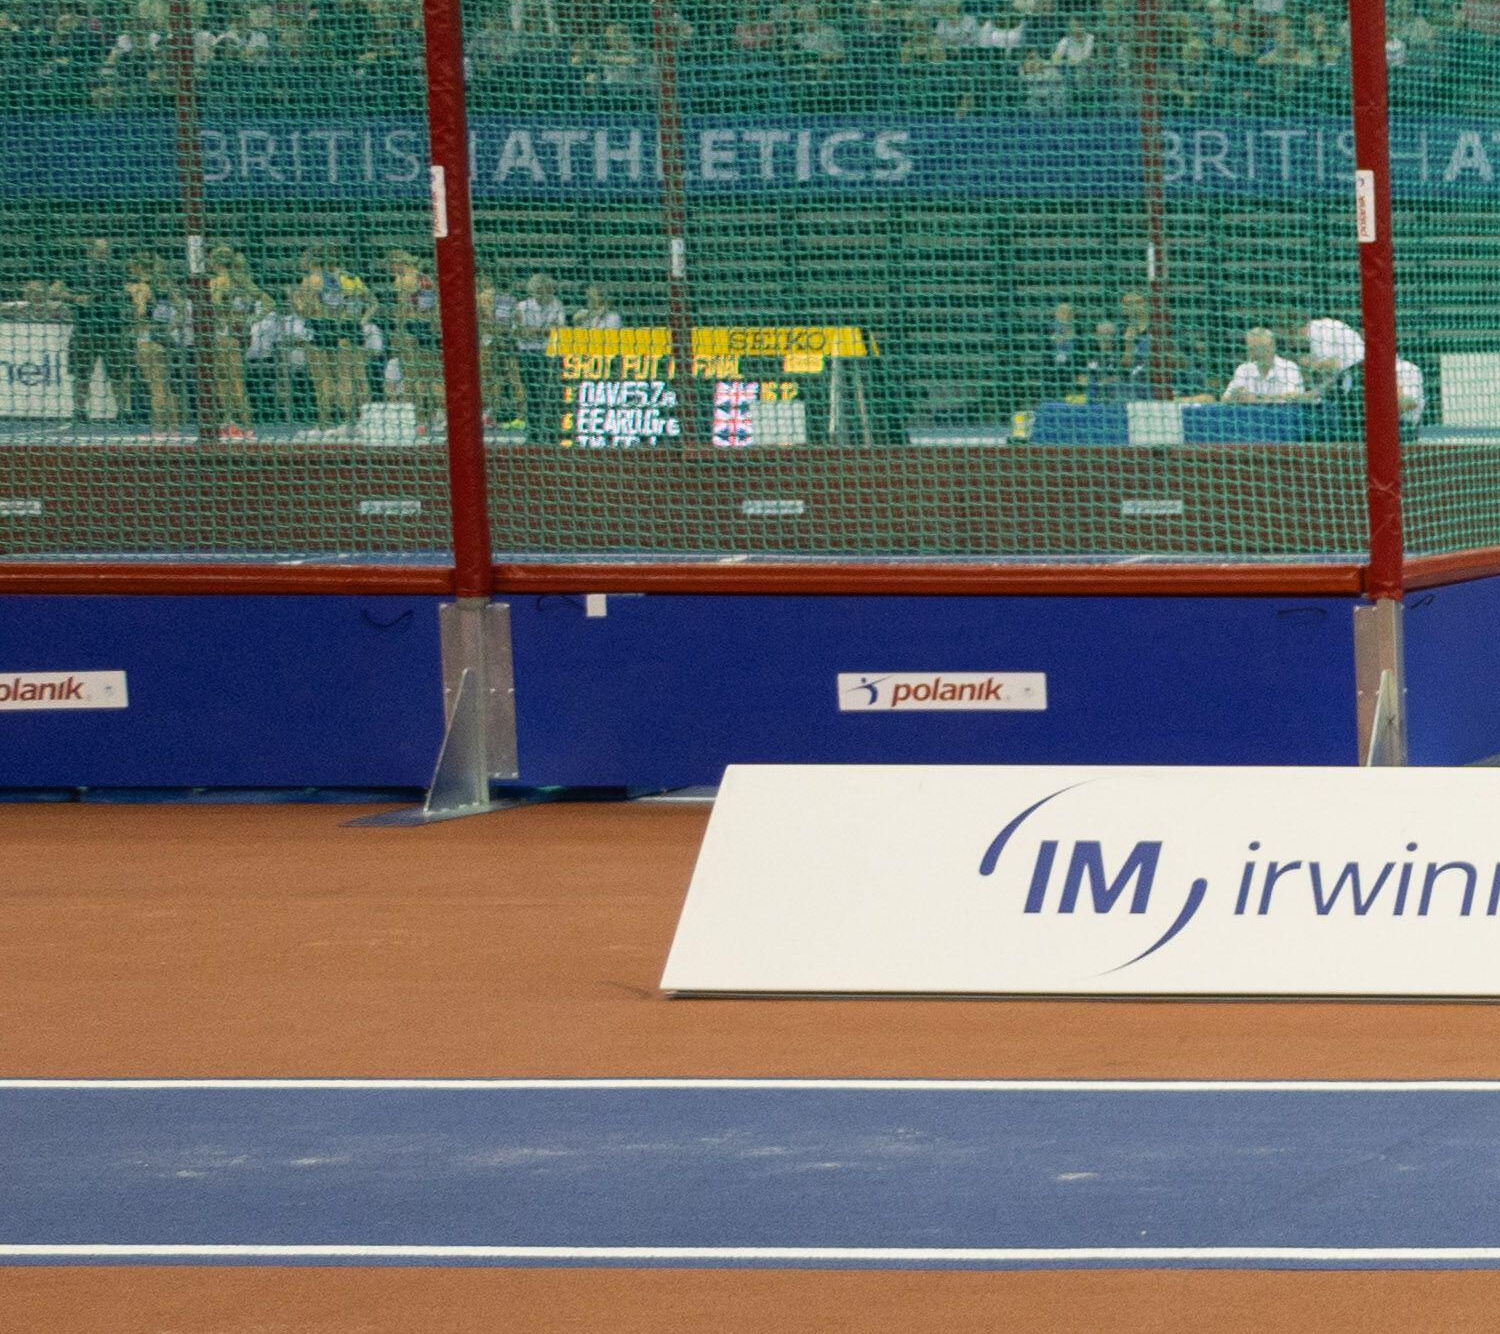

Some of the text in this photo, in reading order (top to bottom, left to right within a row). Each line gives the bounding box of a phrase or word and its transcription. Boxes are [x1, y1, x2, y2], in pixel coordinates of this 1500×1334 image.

[727, 330, 827, 352] SEIKO
[890, 676, 1004, 708] polanik
[1022, 839, 1164, 915] IM
